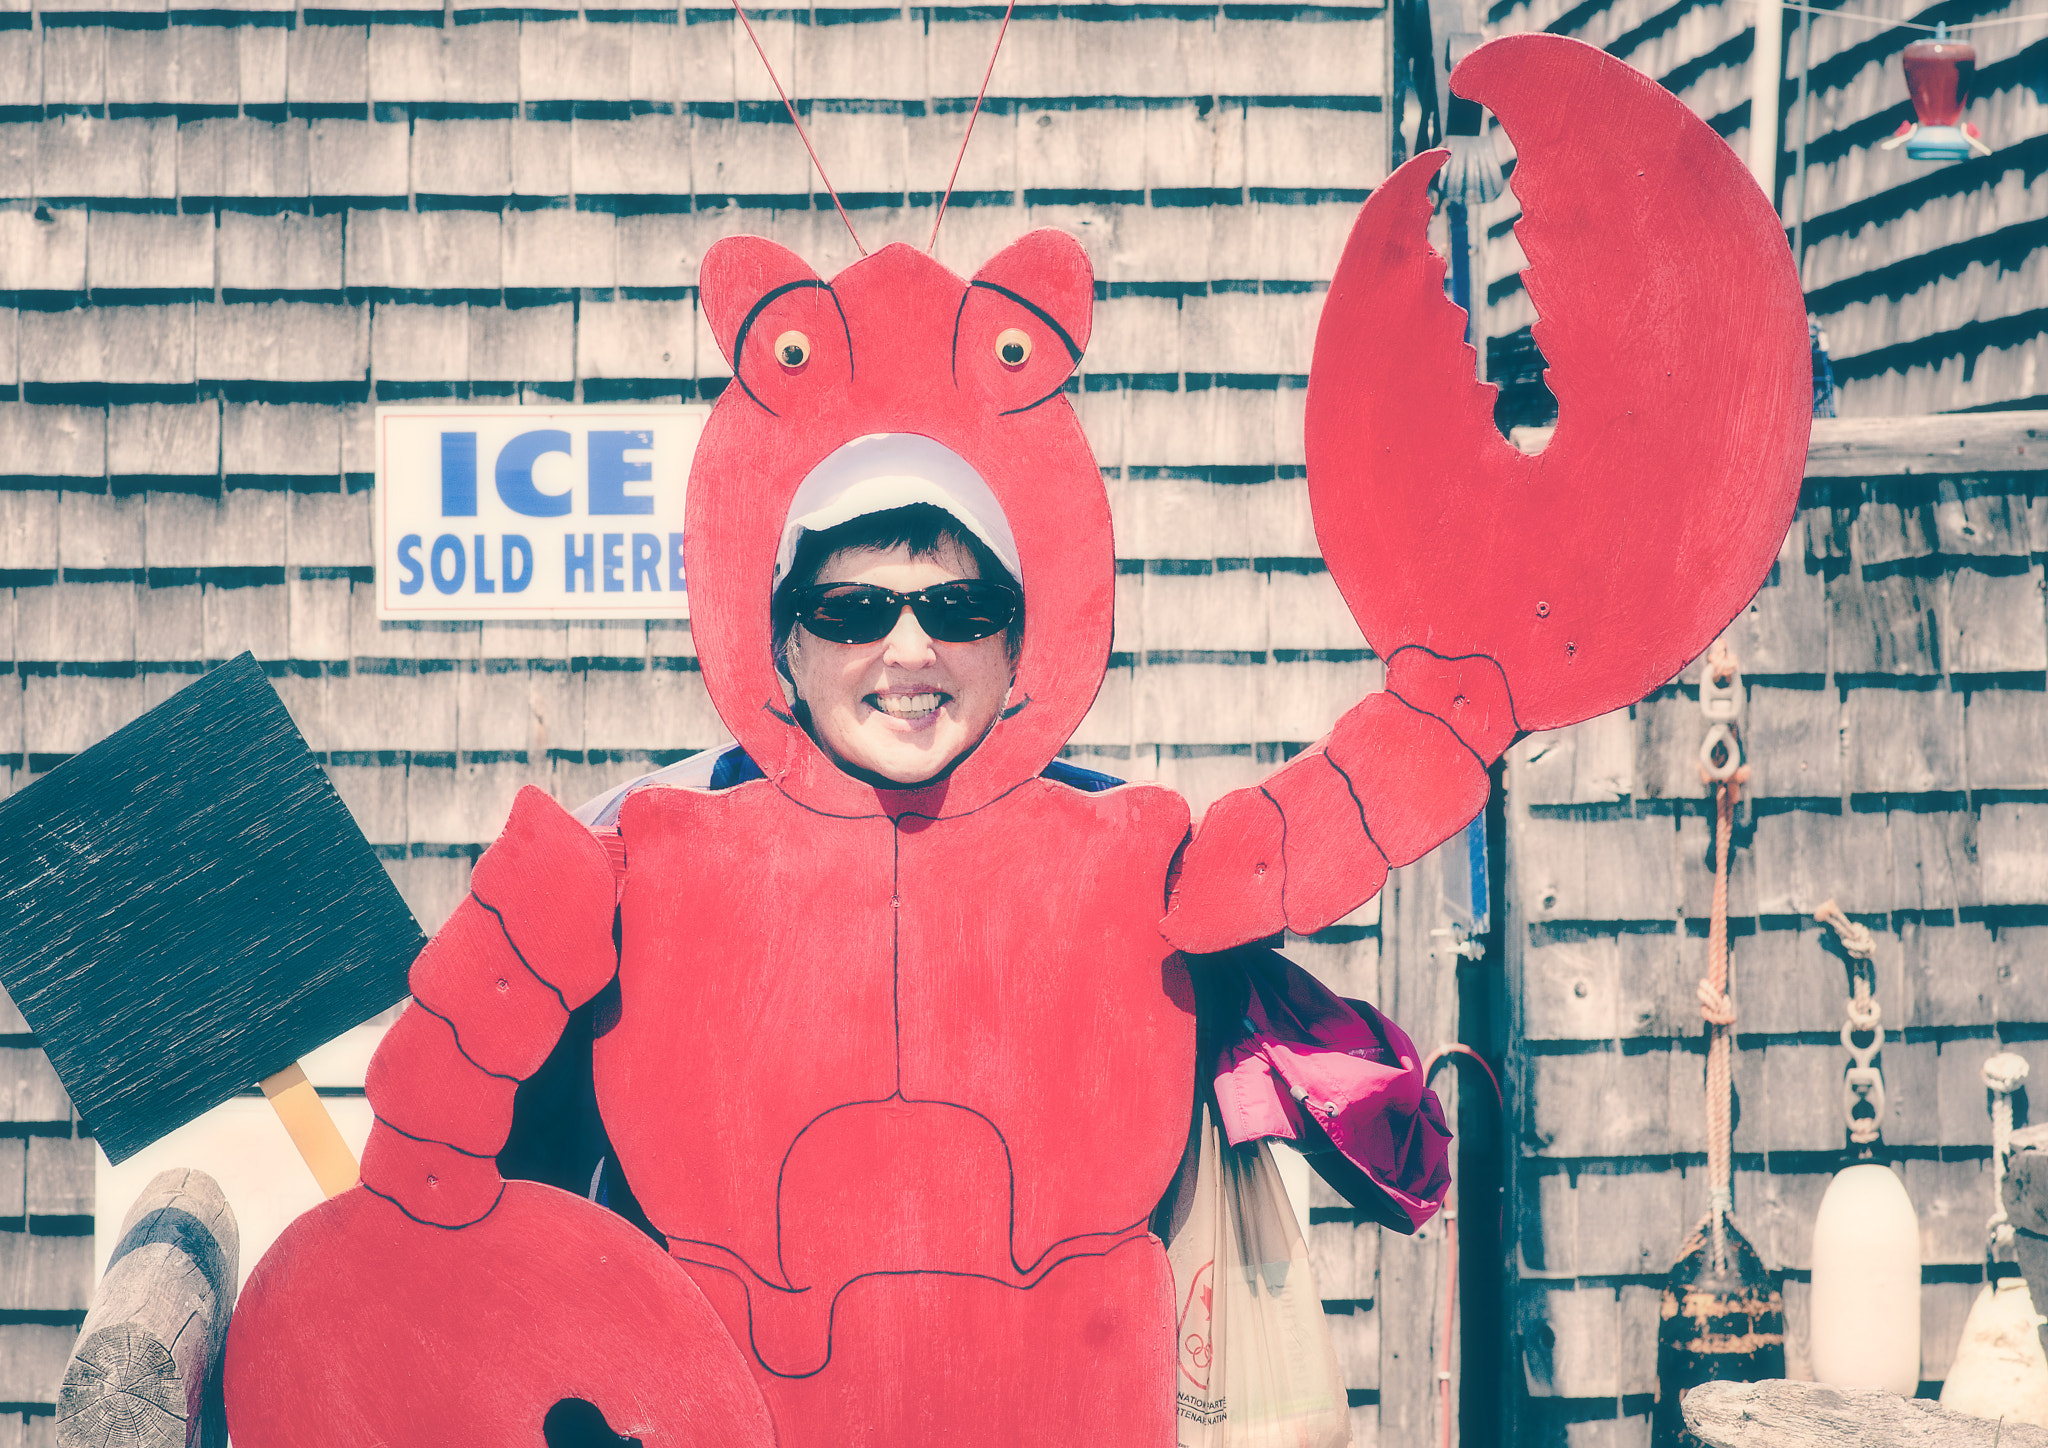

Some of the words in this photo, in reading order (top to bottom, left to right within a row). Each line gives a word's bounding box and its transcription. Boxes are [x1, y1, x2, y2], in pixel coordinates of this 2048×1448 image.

[441, 429, 654, 517] ICE
[398, 534, 533, 595] SOLD
[565, 533, 687, 592] HERE
